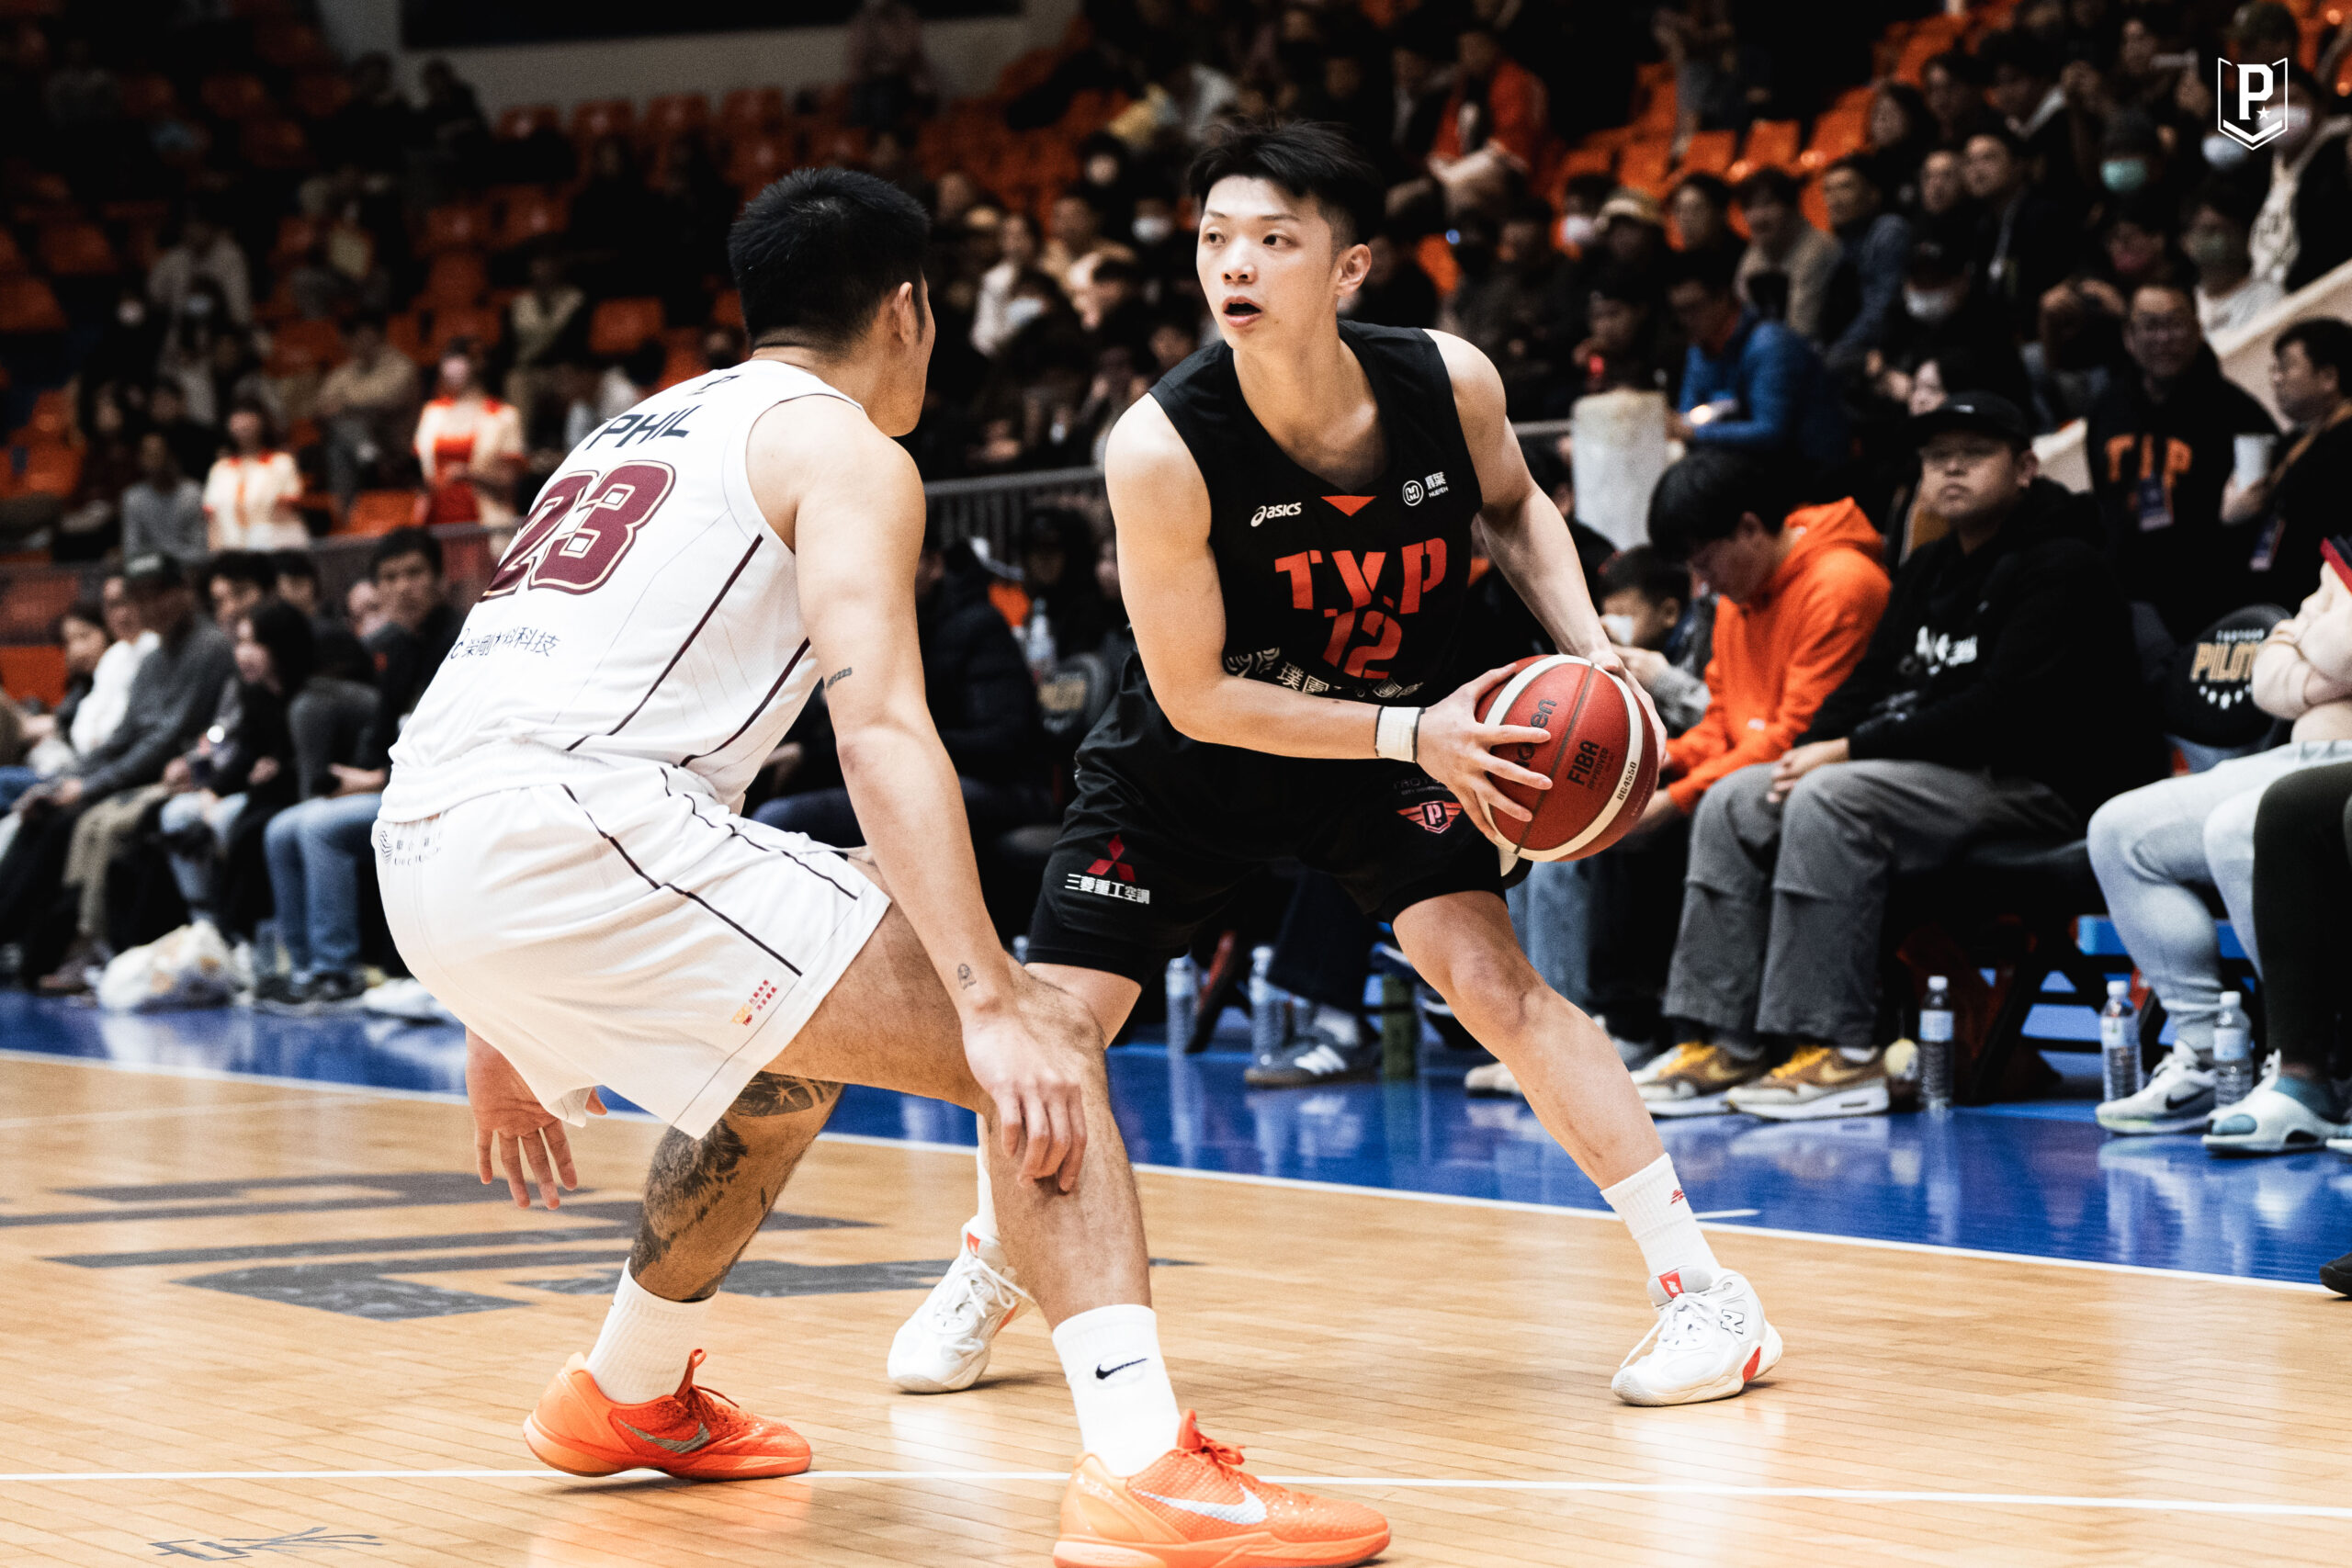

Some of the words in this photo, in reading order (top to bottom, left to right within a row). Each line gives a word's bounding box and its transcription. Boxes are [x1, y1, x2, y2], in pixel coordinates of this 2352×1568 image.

[586, 404, 703, 450] PHIL
[478, 459, 676, 604] 23
[1274, 537, 1447, 615] TYP
[1322, 609, 1403, 679] 12
[2190, 642, 2257, 682] PILOT
[1566, 739, 1600, 786] FIBA
[1065, 874, 1150, 905] 三菱重工空調
